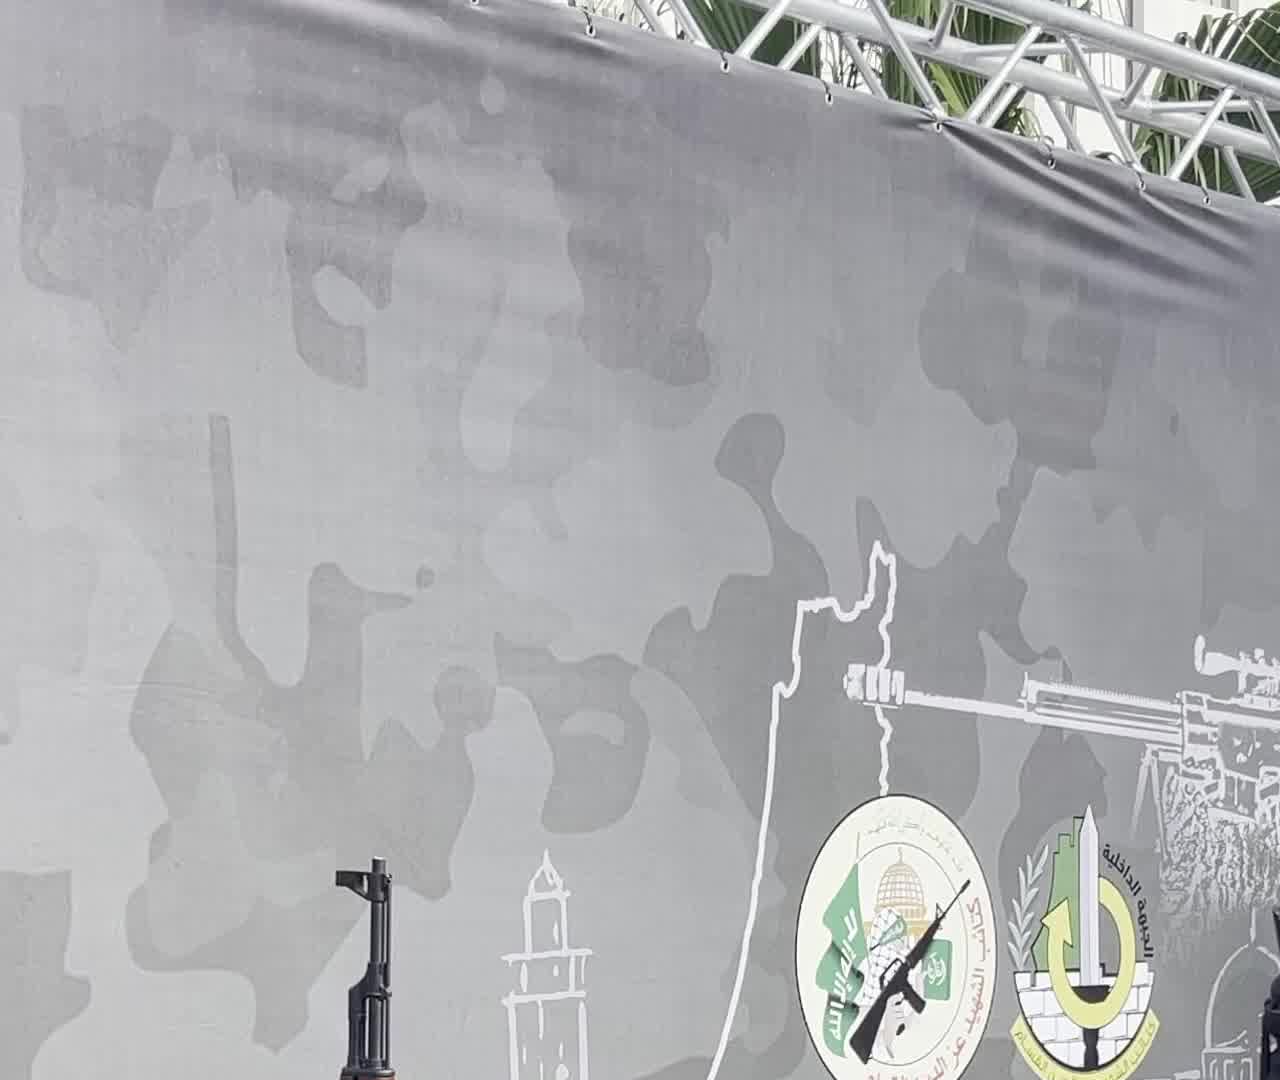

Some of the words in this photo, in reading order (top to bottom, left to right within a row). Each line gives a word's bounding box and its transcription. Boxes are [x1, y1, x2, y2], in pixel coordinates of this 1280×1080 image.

[1102, 843, 1142, 897] الداخلية
[1136, 898, 1155, 958] الجبهة
[965, 967, 986, 1035] الشهيد
